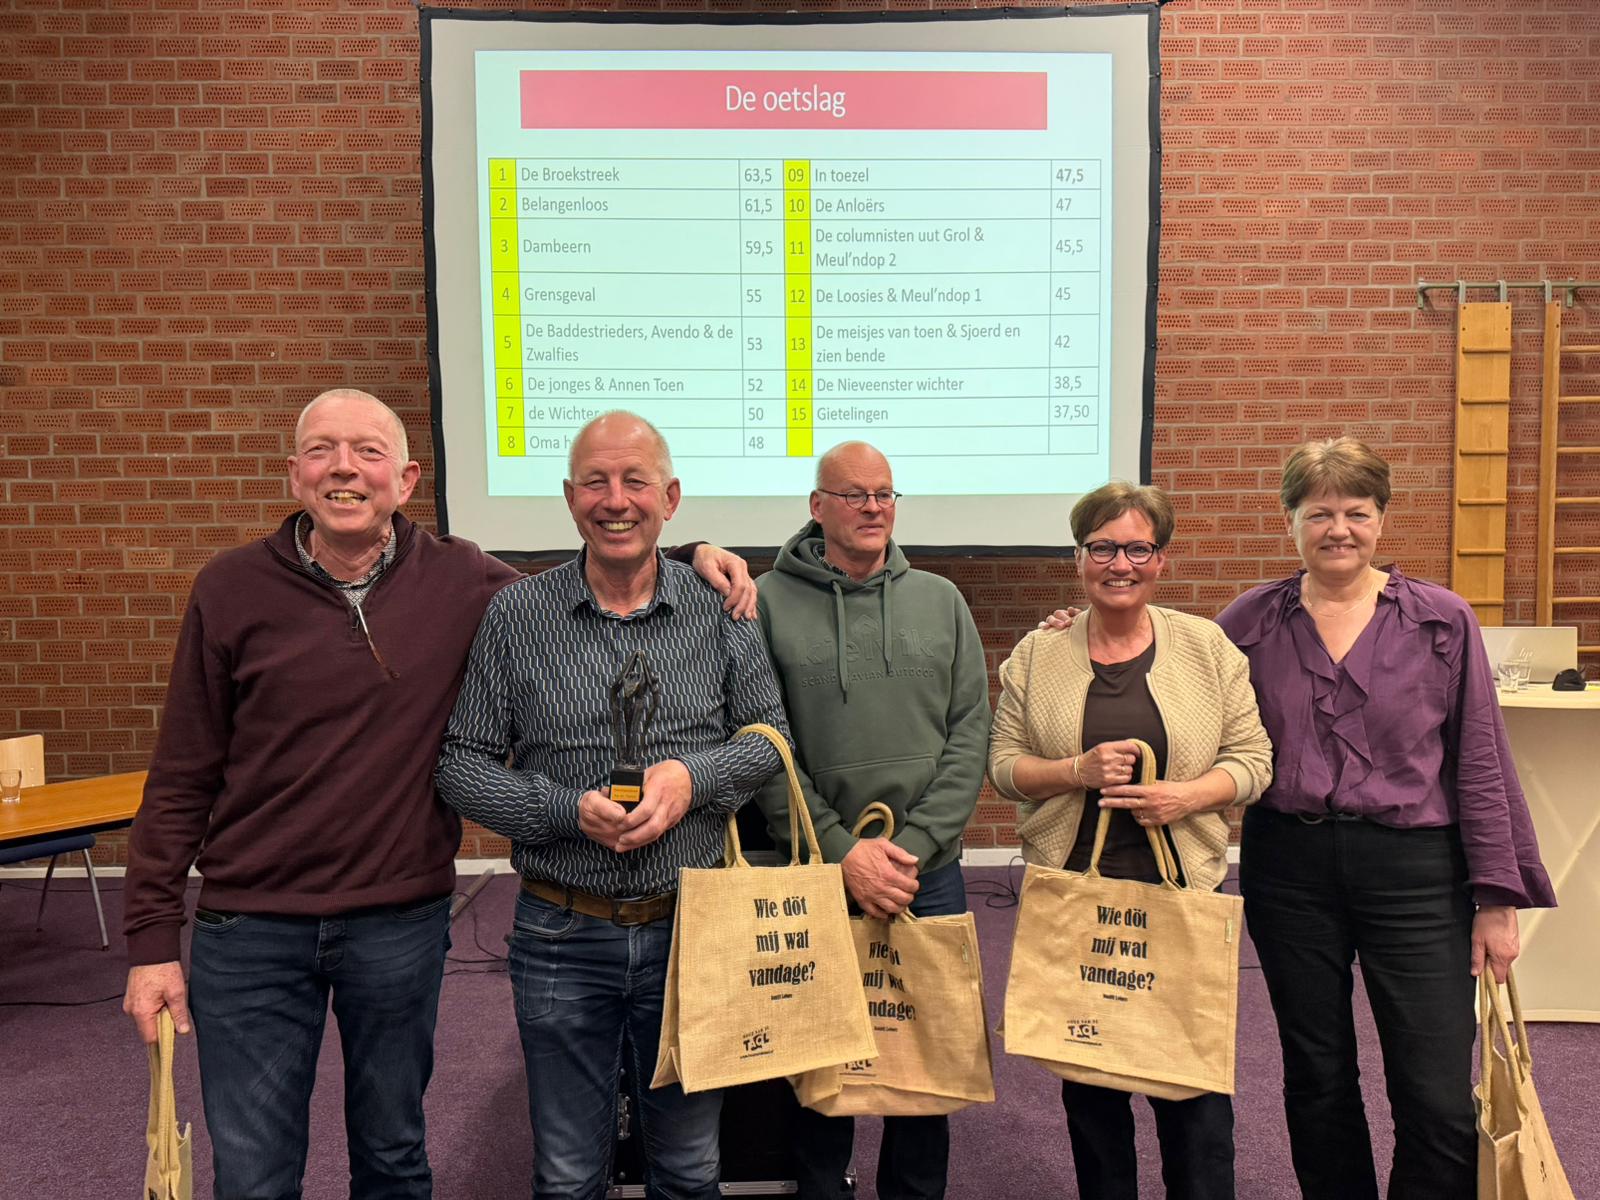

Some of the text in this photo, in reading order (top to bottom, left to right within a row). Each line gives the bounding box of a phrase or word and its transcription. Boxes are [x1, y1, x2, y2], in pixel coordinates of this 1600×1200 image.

[725, 83, 846, 119] De oetslag
[498, 167, 507, 182] 1
[521, 165, 620, 182] De Broekstreek
[744, 167, 772, 185] 63,5
[787, 167, 804, 183] 09
[815, 167, 869, 183] In toezel
[1055, 167, 1084, 185] 47,5
[499, 197, 508, 211] 2
[521, 195, 609, 215] Belangenloos
[744, 198, 773, 215] 61,5
[789, 198, 805, 213] 10
[815, 196, 885, 213] De Anloërs
[1055, 197, 1072, 212] 47
[815, 226, 985, 243] De columnisten uut Grol &
[500, 238, 509, 253] 3
[523, 238, 592, 254] Dambeern
[745, 240, 774, 257] 59,5
[789, 240, 805, 255] 11
[1055, 239, 1084, 256] 45,5
[888, 252, 897, 267] 2
[501, 287, 510, 301] 4
[524, 287, 596, 305] Grensgeval
[746, 288, 762, 303] 55
[790, 289, 806, 303] 12
[816, 288, 834, 303] De
[836, 288, 884, 303] Loosies
[886, 287, 898, 303] &
[974, 288, 982, 302] 1
[1055, 286, 1071, 301] 45
[525, 322, 734, 341] De Baddestrieders, Avendo & de
[816, 322, 1021, 343] De meisjes van toen & Sjoerd en
[503, 335, 512, 350] 5
[747, 336, 763, 351] 53
[791, 337, 806, 351] 13
[1054, 334, 1071, 349] 42
[525, 346, 579, 362] Zwalfies
[816, 347, 886, 363] zien bende
[505, 376, 514, 391] 6
[527, 376, 685, 395] De jonges & Annen Toen
[747, 377, 764, 392] 52
[791, 378, 806, 392] 14
[816, 376, 965, 392] De Nieveenster wichter
[1054, 375, 1082, 392] 38,5
[506, 405, 515, 420] 7
[528, 405, 600, 420] de Wichter
[748, 406, 764, 421] 50
[791, 407, 807, 421] 15
[816, 406, 889, 424] Gietelingen
[1053, 404, 1090, 421] 37,50
[507, 435, 516, 449] 8
[529, 435, 560, 449] Oma
[748, 435, 765, 450] 48
[753, 895, 808, 919] Wie döt
[1097, 905, 1147, 929] Wie döt
[756, 928, 809, 954] mij wat
[1091, 937, 1147, 960] mij wat
[869, 941, 889, 959] Wie
[749, 961, 816, 988] vandage?
[863, 969, 884, 989] mij
[1080, 965, 1156, 991] vandage?
[868, 1000, 917, 1021] ndage?
